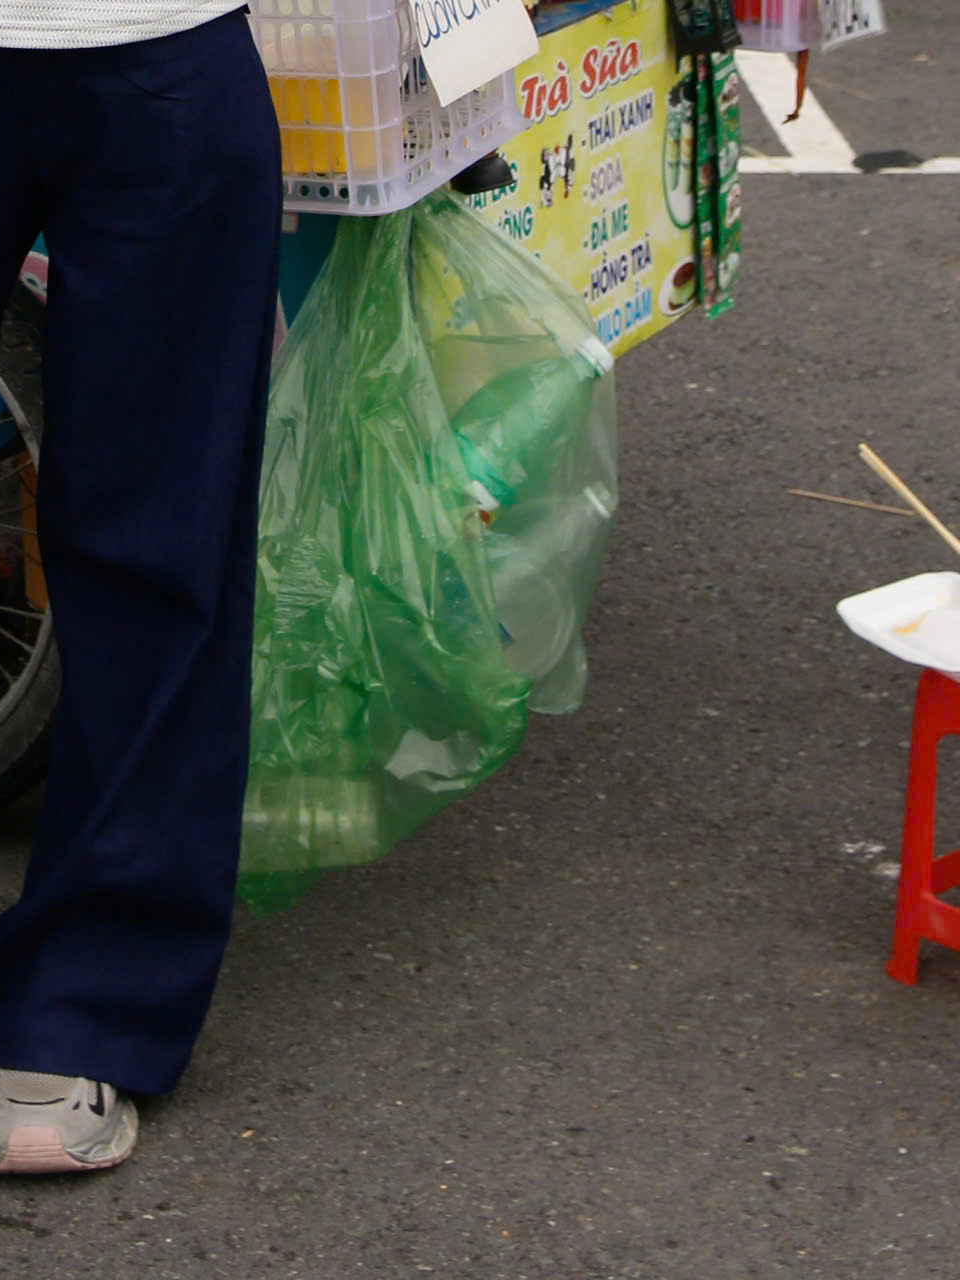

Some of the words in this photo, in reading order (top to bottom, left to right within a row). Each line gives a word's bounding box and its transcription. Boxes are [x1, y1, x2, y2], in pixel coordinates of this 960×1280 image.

[520, 60, 570, 120] Trà
[580, 39, 640, 94] Sữa
[588, 104, 616, 150] THÁI
[618, 91, 654, 135] XANH
[591, 158, 623, 200] SODA
[611, 202, 629, 239] ME
[591, 251, 629, 302] HỒNG
[631, 232, 653, 276] TRÀ
